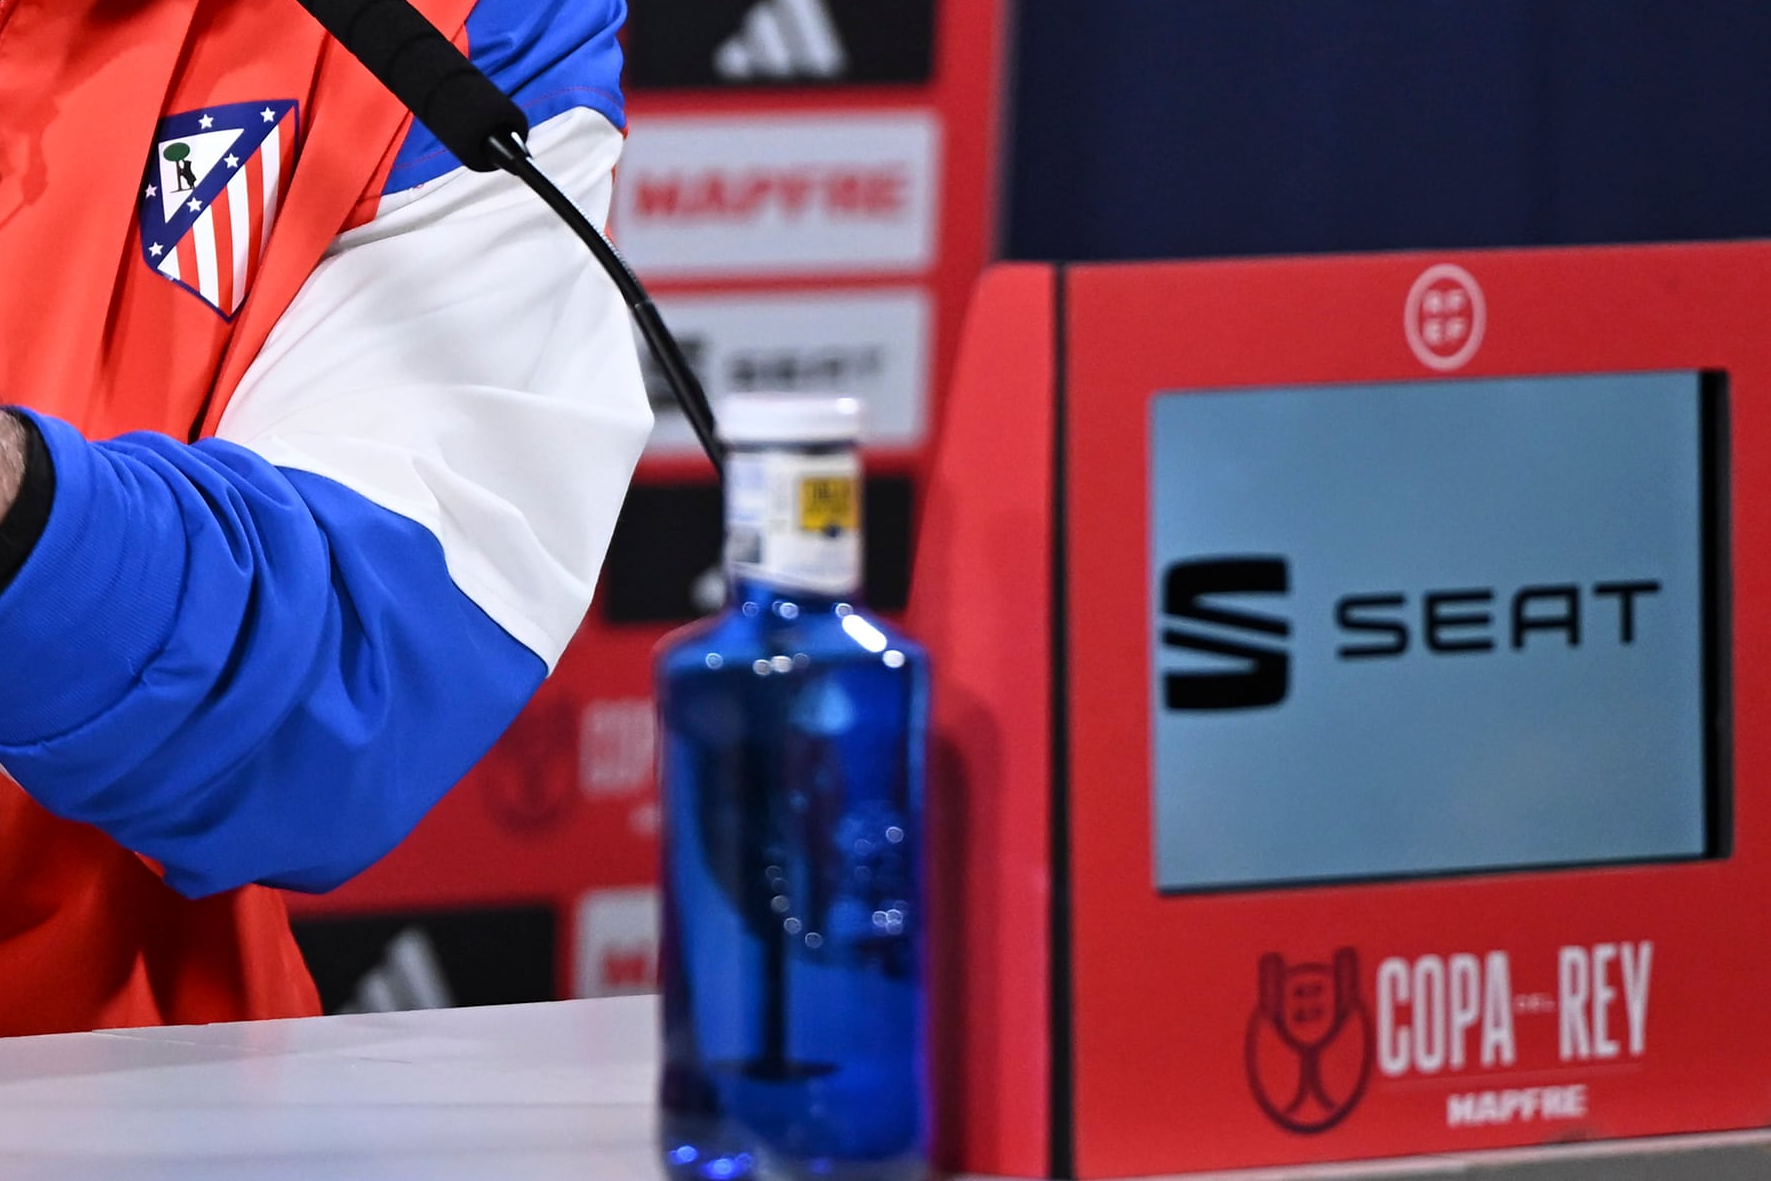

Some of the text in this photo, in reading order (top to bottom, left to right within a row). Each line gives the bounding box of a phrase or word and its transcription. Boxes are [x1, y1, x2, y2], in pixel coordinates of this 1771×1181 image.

[1335, 579, 1662, 660] SEAT
[1377, 951, 1515, 1075] COPA
[1559, 942, 1652, 1060] REY
[1447, 1085, 1585, 1126] MAPFRE
